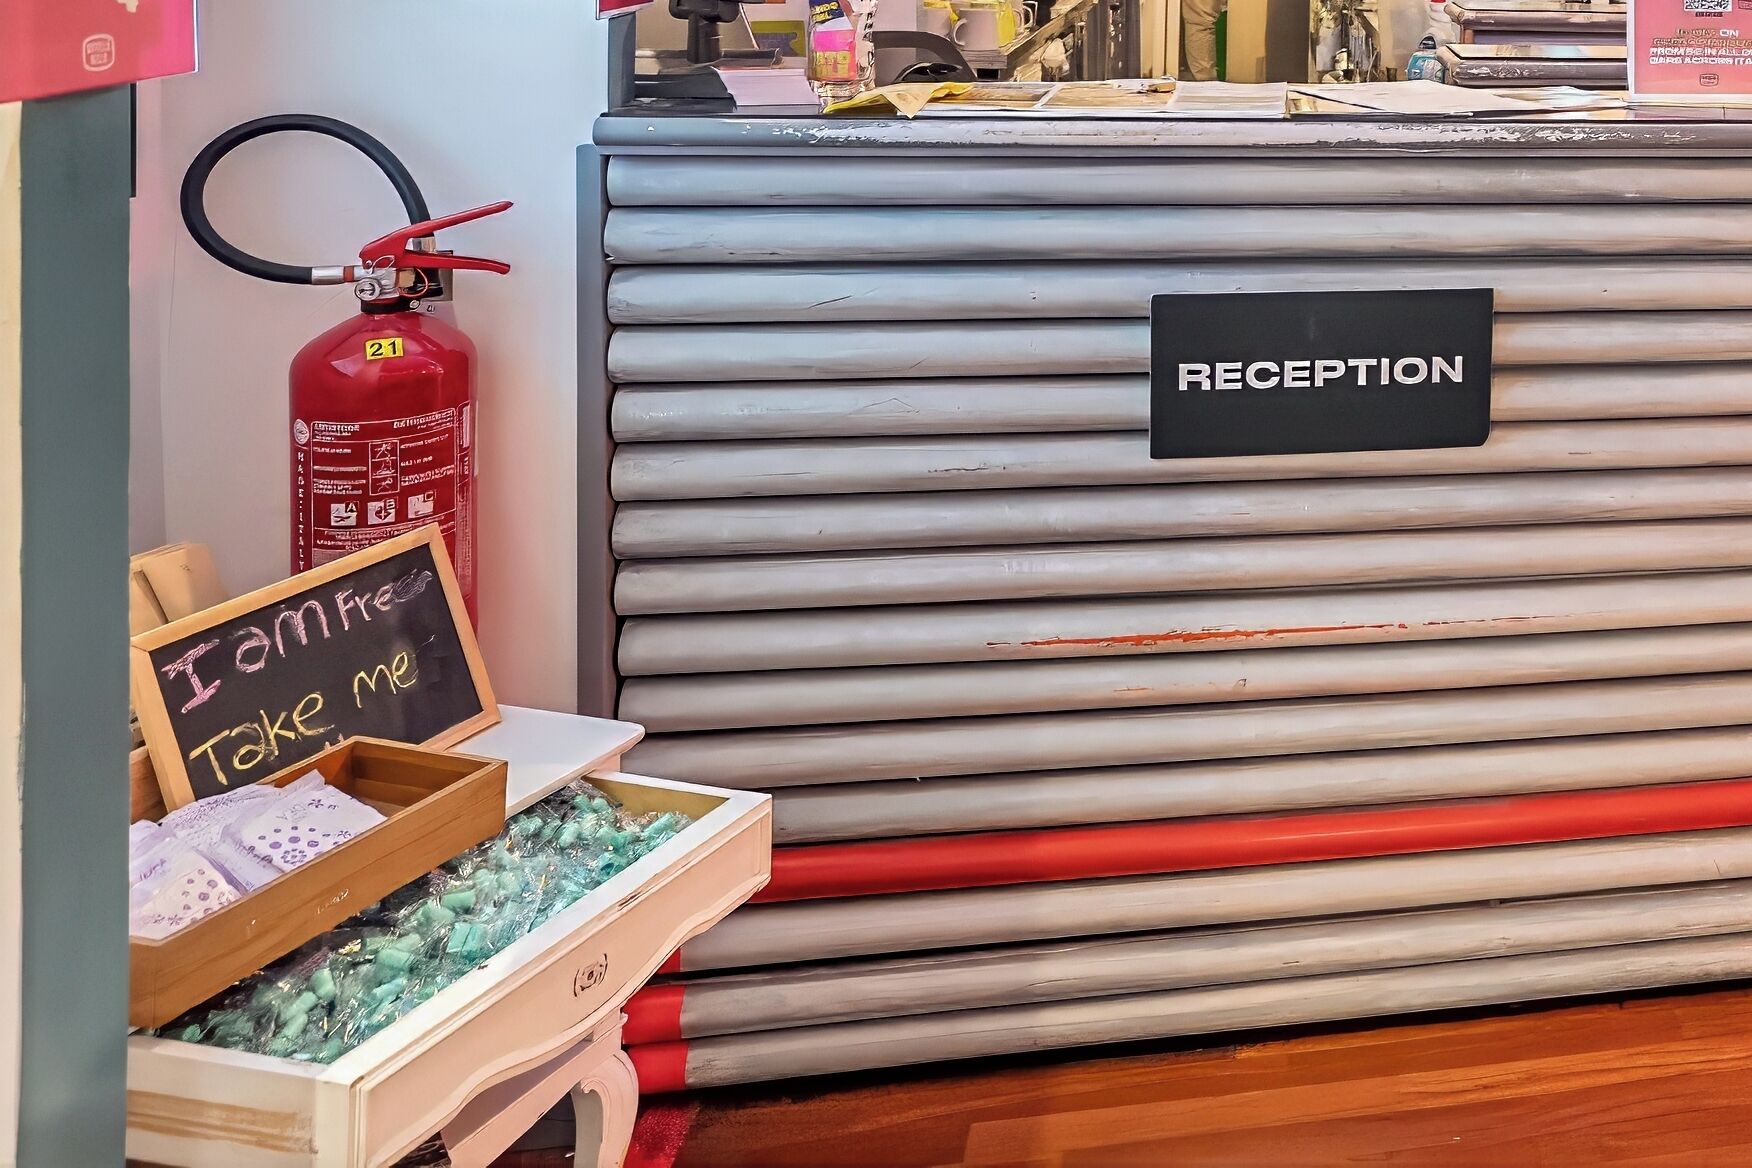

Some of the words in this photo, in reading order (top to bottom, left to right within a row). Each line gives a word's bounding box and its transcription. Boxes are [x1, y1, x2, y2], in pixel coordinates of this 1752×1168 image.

[369, 340, 400, 357] 21
[1178, 355, 1464, 391] RECEPTION
[161, 639, 221, 714] I
[189, 691, 334, 785] Take
